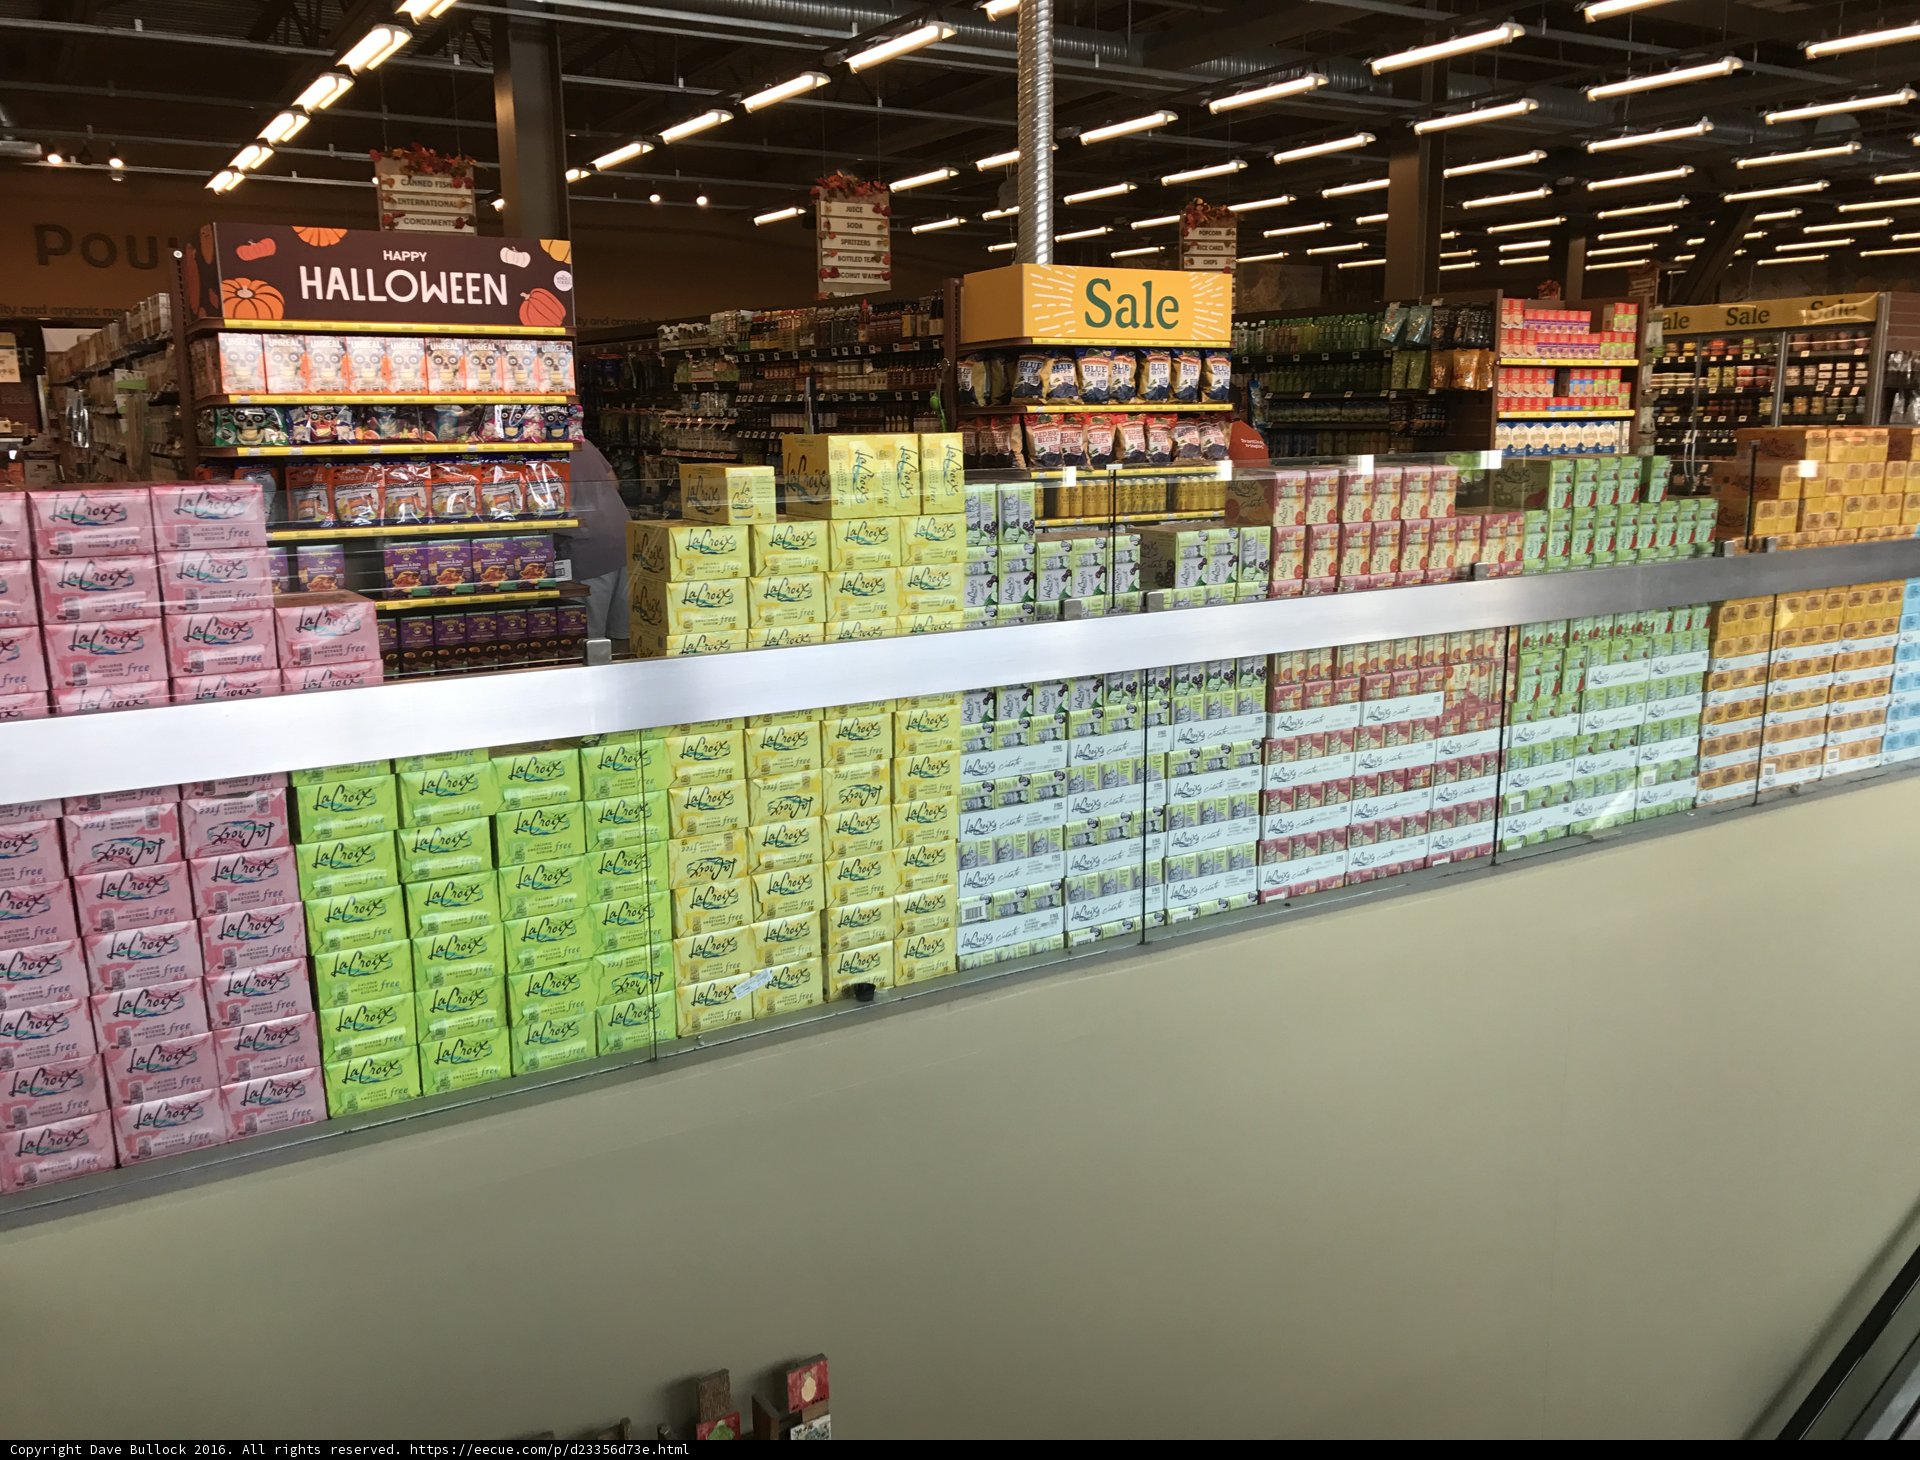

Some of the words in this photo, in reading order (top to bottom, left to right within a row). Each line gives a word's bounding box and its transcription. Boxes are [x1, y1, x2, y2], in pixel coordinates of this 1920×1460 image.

[401, 178, 433, 188] CANNED
[404, 217, 456, 226] CONDIMENTS
[841, 239, 871, 247] SPRITZERS
[383, 250, 427, 262] HAPPY
[300, 266, 508, 306] HALLOWEEN
[1085, 278, 1180, 330] Sale
[1725, 306, 1771, 327] Sale
[1807, 299, 1858, 320] Sale
[1663, 311, 1690, 330] ale
[431, 341, 458, 351] UNREAL
[468, 343, 497, 351] UNREAL
[506, 343, 533, 351] UNREAL
[1019, 361, 1042, 369] BLUE
[50, 491, 124, 525] LaCroix
[175, 486, 245, 517] LaCroix
[686, 528, 734, 551] LaCroix
[769, 524, 815, 547] LaCroix
[844, 520, 886, 543] LaCroix
[914, 516, 954, 539] LaCroix
[58, 558, 130, 589] LaCroix
[177, 550, 245, 579] LaCroix
[764, 575, 810, 599] LaCroix
[840, 572, 884, 594] LaCroix
[908, 567, 950, 590] LaCroix
[681, 582, 731, 606] LaCroix
[184, 613, 251, 644] LaCroix
[297, 606, 361, 633] LaCroix
[69, 623, 140, 652] LaCroix
[125, 661, 150, 676] free
[240, 651, 263, 666] free
[836, 717, 879, 740] LaCroix
[906, 711, 947, 731] LaCroix
[679, 735, 730, 761] LaCroix
[760, 726, 807, 751] LaCroix
[509, 755, 563, 781] LaCroix
[418, 769, 476, 797] LaCroix
[313, 783, 375, 812] LaCroix
[684, 786, 734, 811] LaCroix
[514, 809, 568, 834] LaCroix
[836, 811, 879, 835] LaCroix
[412, 827, 471, 853] LaCroix
[762, 823, 808, 848] LaCroix
[313, 841, 375, 869] LaCroix
[904, 848, 945, 867] LaCroix
[20, 866, 43, 877] free
[212, 855, 276, 882] LaCroix
[517, 864, 569, 890] LaCroix
[837, 859, 880, 882] LaCroix
[98, 869, 165, 899] LaCroix
[263, 888, 284, 899] free
[424, 881, 480, 907] LaCroix
[767, 872, 811, 896] LaCroix
[324, 896, 383, 923] LaCroix
[690, 885, 737, 911] LaCroix
[151, 906, 176, 917] free
[219, 912, 281, 940] LaCroix
[522, 916, 577, 942] LaCroix
[764, 919, 808, 943] LaCroix
[107, 929, 175, 959] LaCroix
[272, 945, 291, 956] free
[428, 933, 484, 960] LaCroix
[689, 934, 737, 959] LaCroix
[331, 949, 392, 977] LaCroix
[225, 968, 287, 996] LaCroix
[525, 971, 578, 997] LaCroix
[113, 988, 180, 1017] LaCroix
[276, 999, 296, 1009] free
[430, 987, 484, 1013] LaCroix
[336, 1004, 395, 1031] LaCroix
[235, 1023, 296, 1050] LaCroix
[525, 1019, 579, 1044] LaCroix
[128, 1043, 194, 1072] LaCroix
[435, 1038, 489, 1064] LaCroix
[10, 1066, 78, 1096] LaCroix
[342, 1057, 399, 1084] LaCroix
[241, 1078, 302, 1105] LaCroix
[134, 1099, 200, 1128] LaCroix
[16, 1127, 85, 1156] LaCroix
